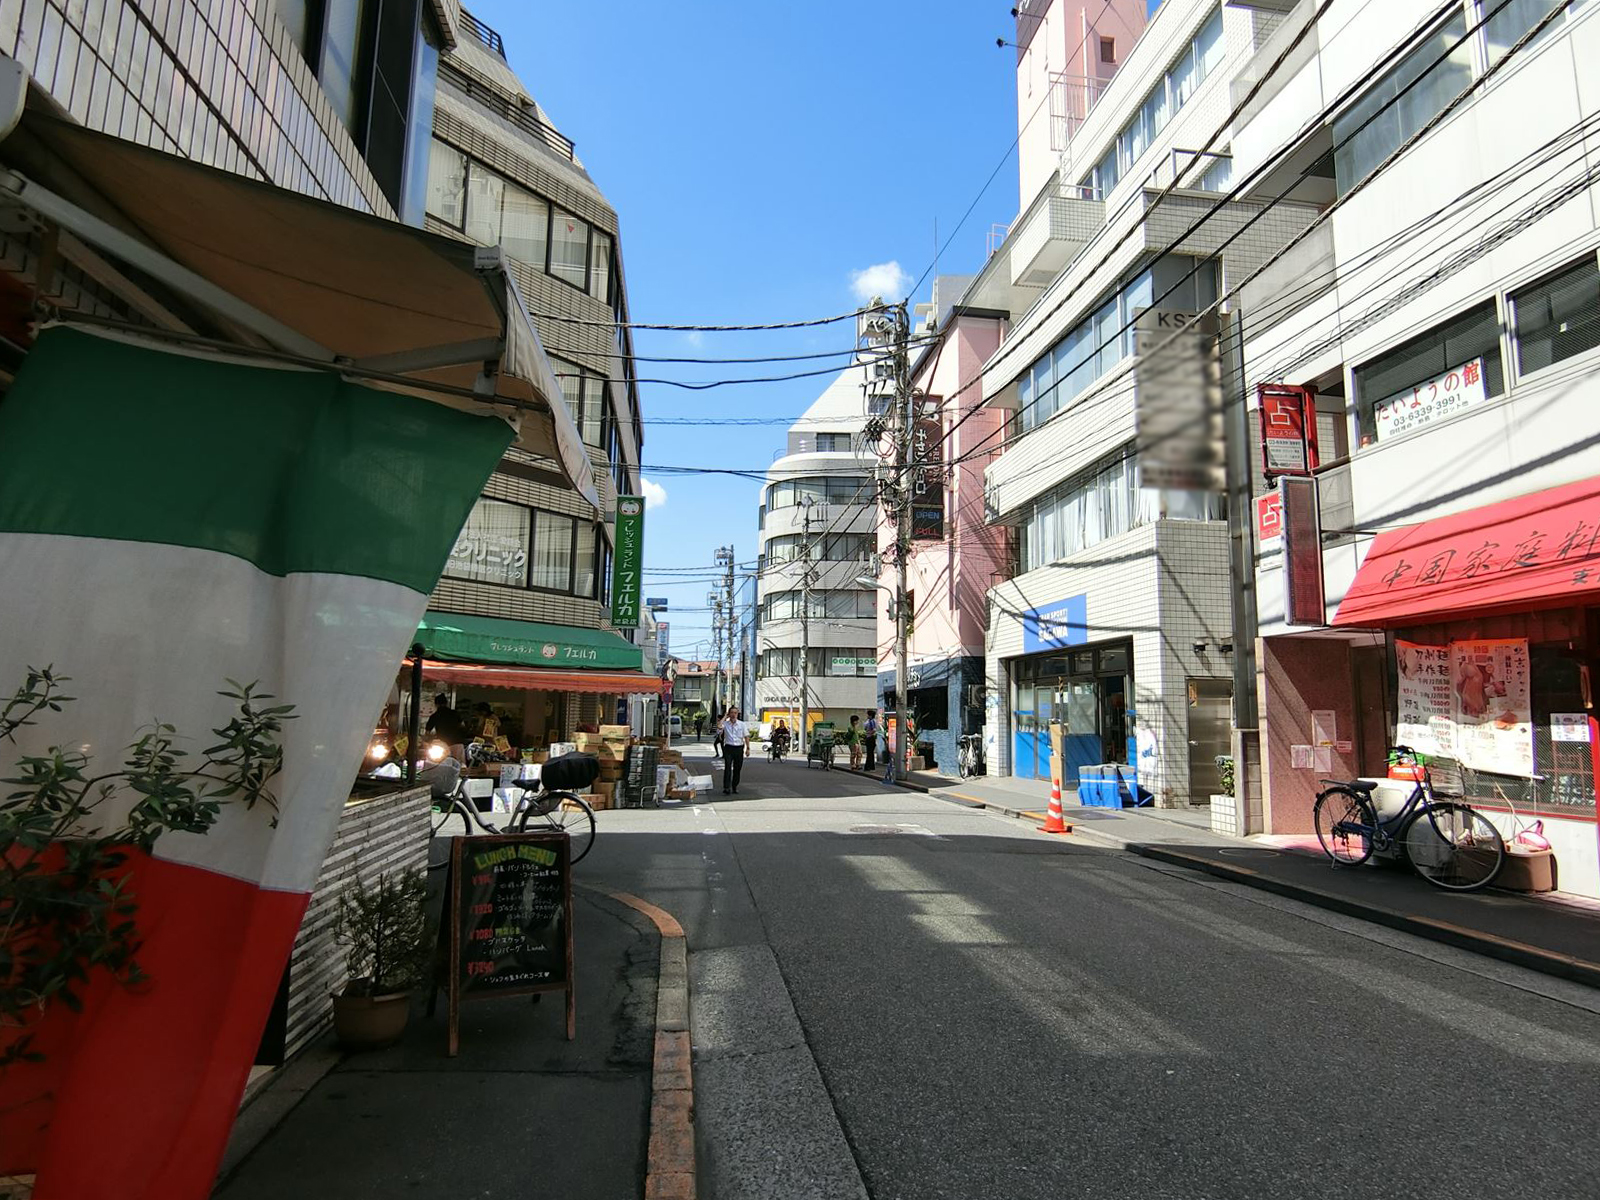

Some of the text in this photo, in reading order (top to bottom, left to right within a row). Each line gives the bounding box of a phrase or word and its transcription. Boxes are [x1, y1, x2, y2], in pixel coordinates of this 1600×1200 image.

[1376, 361, 1480, 423] たいようの館
[1270, 400, 1297, 426] 占
[1393, 393, 1461, 427] 03-6339-3991
[915, 511, 940, 520] OPEN
[474, 844, 558, 870] LUNCH MENU
